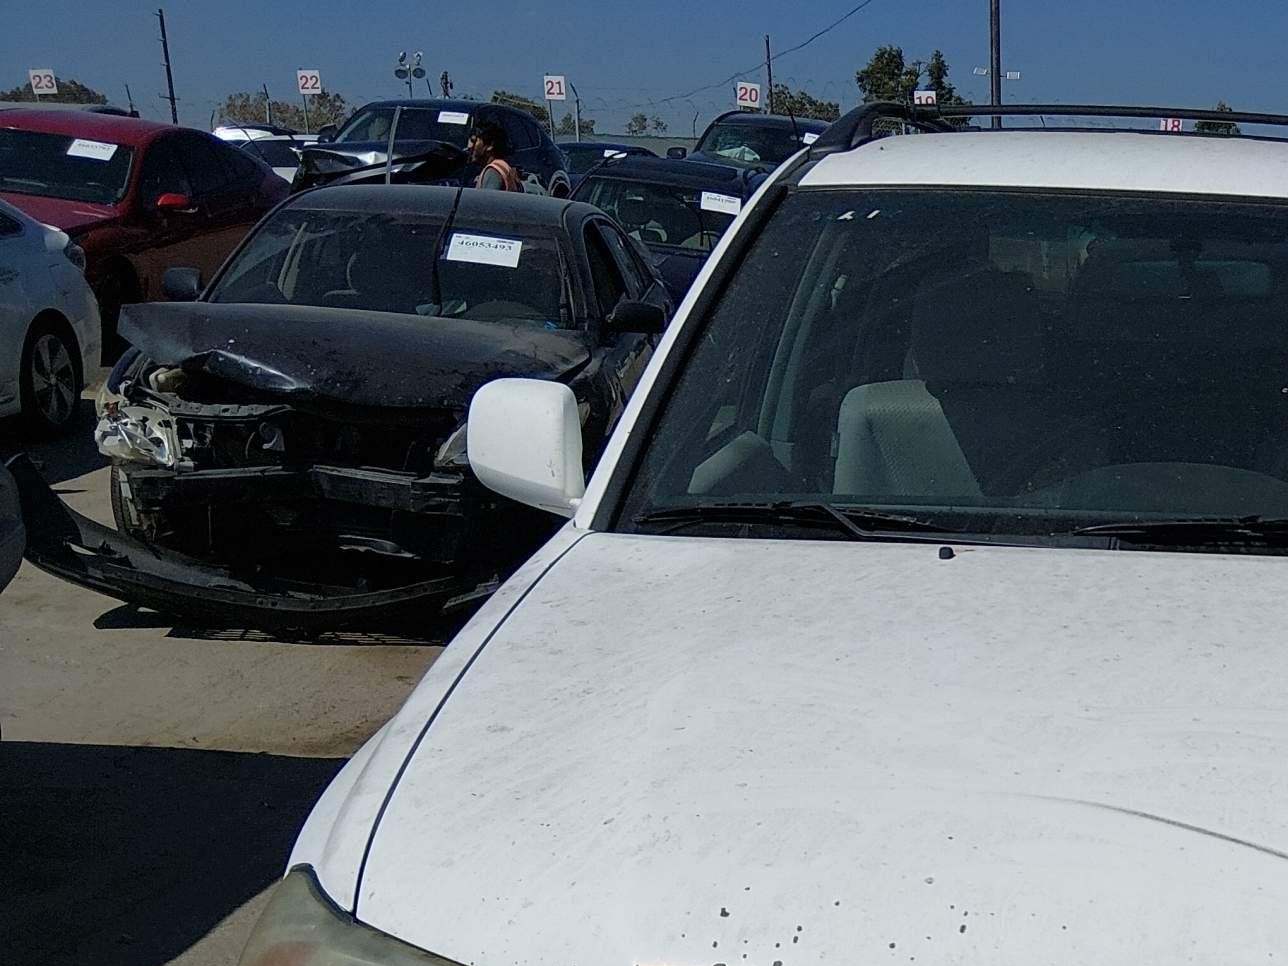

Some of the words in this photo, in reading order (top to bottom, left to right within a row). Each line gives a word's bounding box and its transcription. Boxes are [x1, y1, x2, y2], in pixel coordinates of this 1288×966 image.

[32, 74, 55, 90] 23
[299, 74, 320, 90] 22
[545, 80, 565, 96] 21
[738, 86, 759, 104] 20
[1162, 119, 1181, 132] 18
